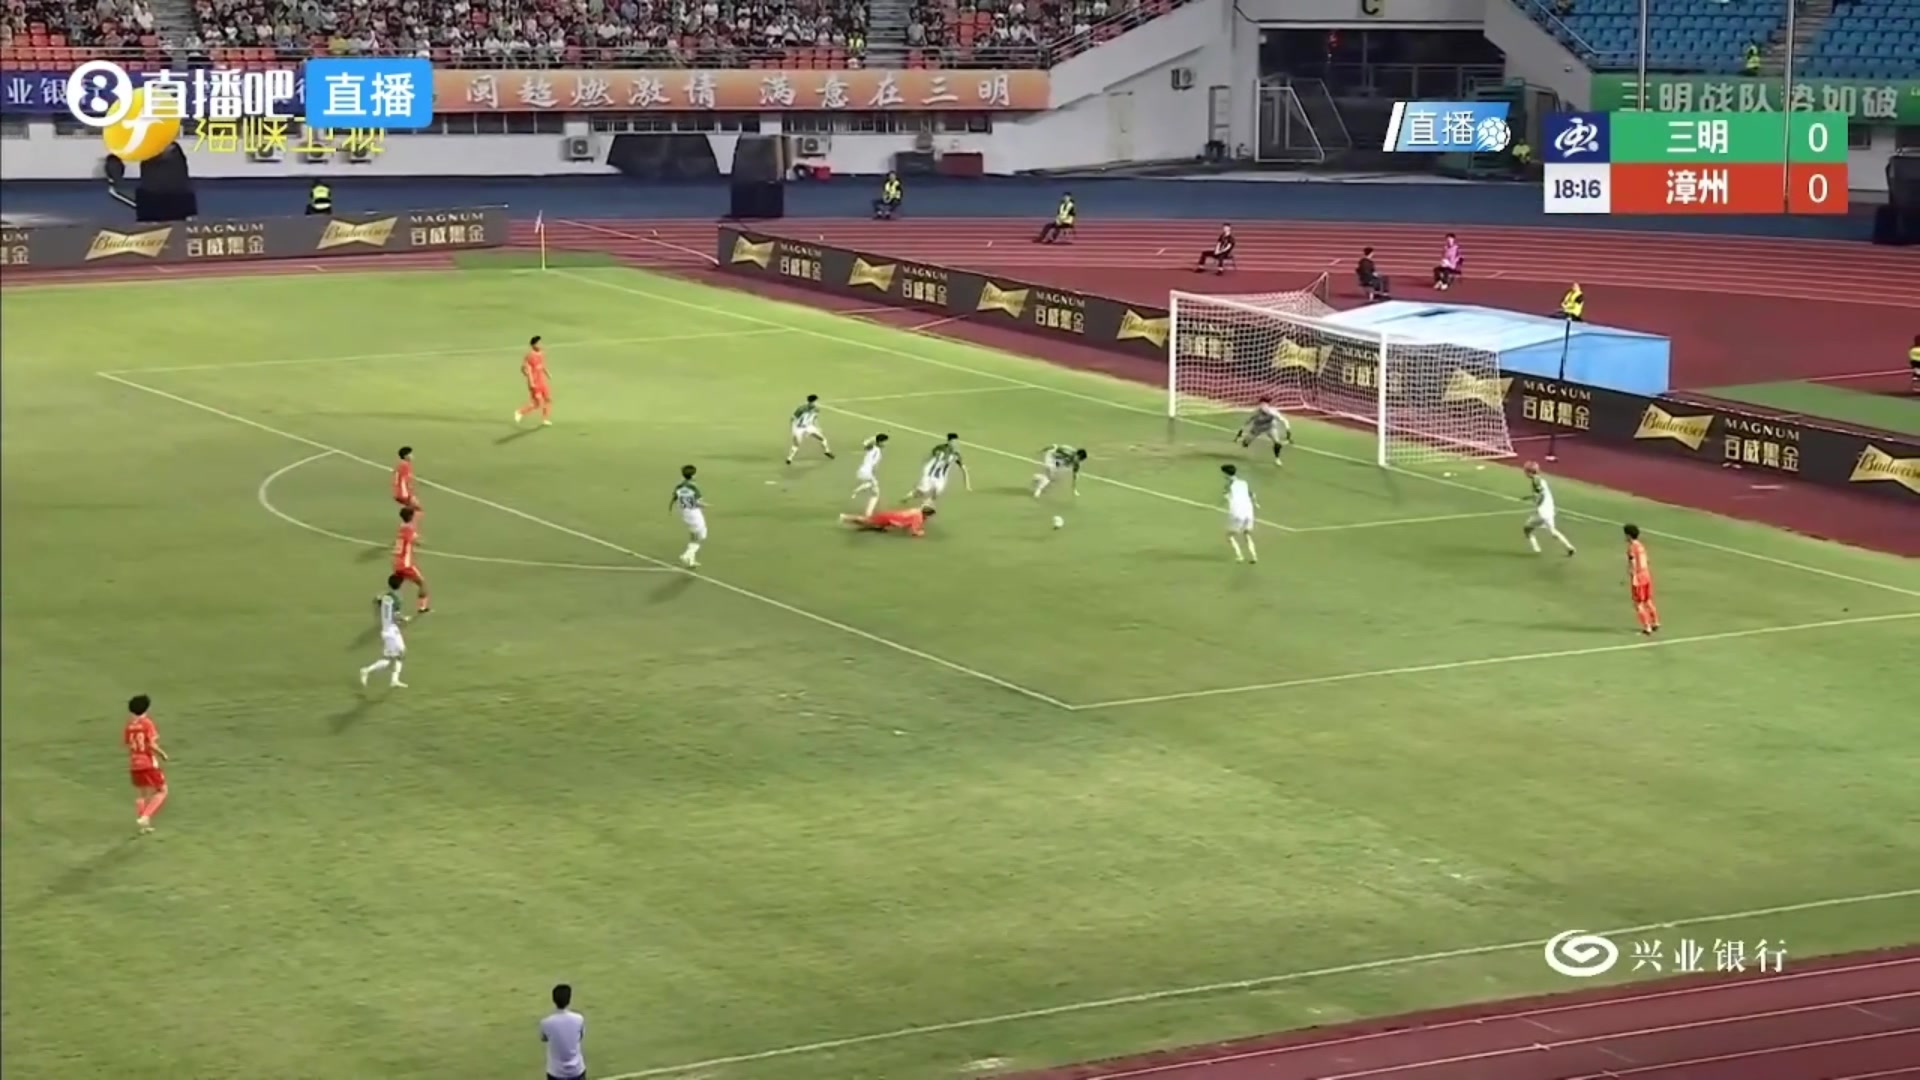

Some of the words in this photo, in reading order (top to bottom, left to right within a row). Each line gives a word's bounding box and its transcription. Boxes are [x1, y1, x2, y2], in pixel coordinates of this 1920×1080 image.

[466, 72, 717, 109] 闽超燃激情
[759, 74, 1012, 108] 满意在三明
[186, 222, 265, 234] MAGNUM
[408, 212, 485, 223] MAGNUM
[1523, 380, 1591, 401] MAGNUM
[1724, 417, 1799, 442] MAGNUM
